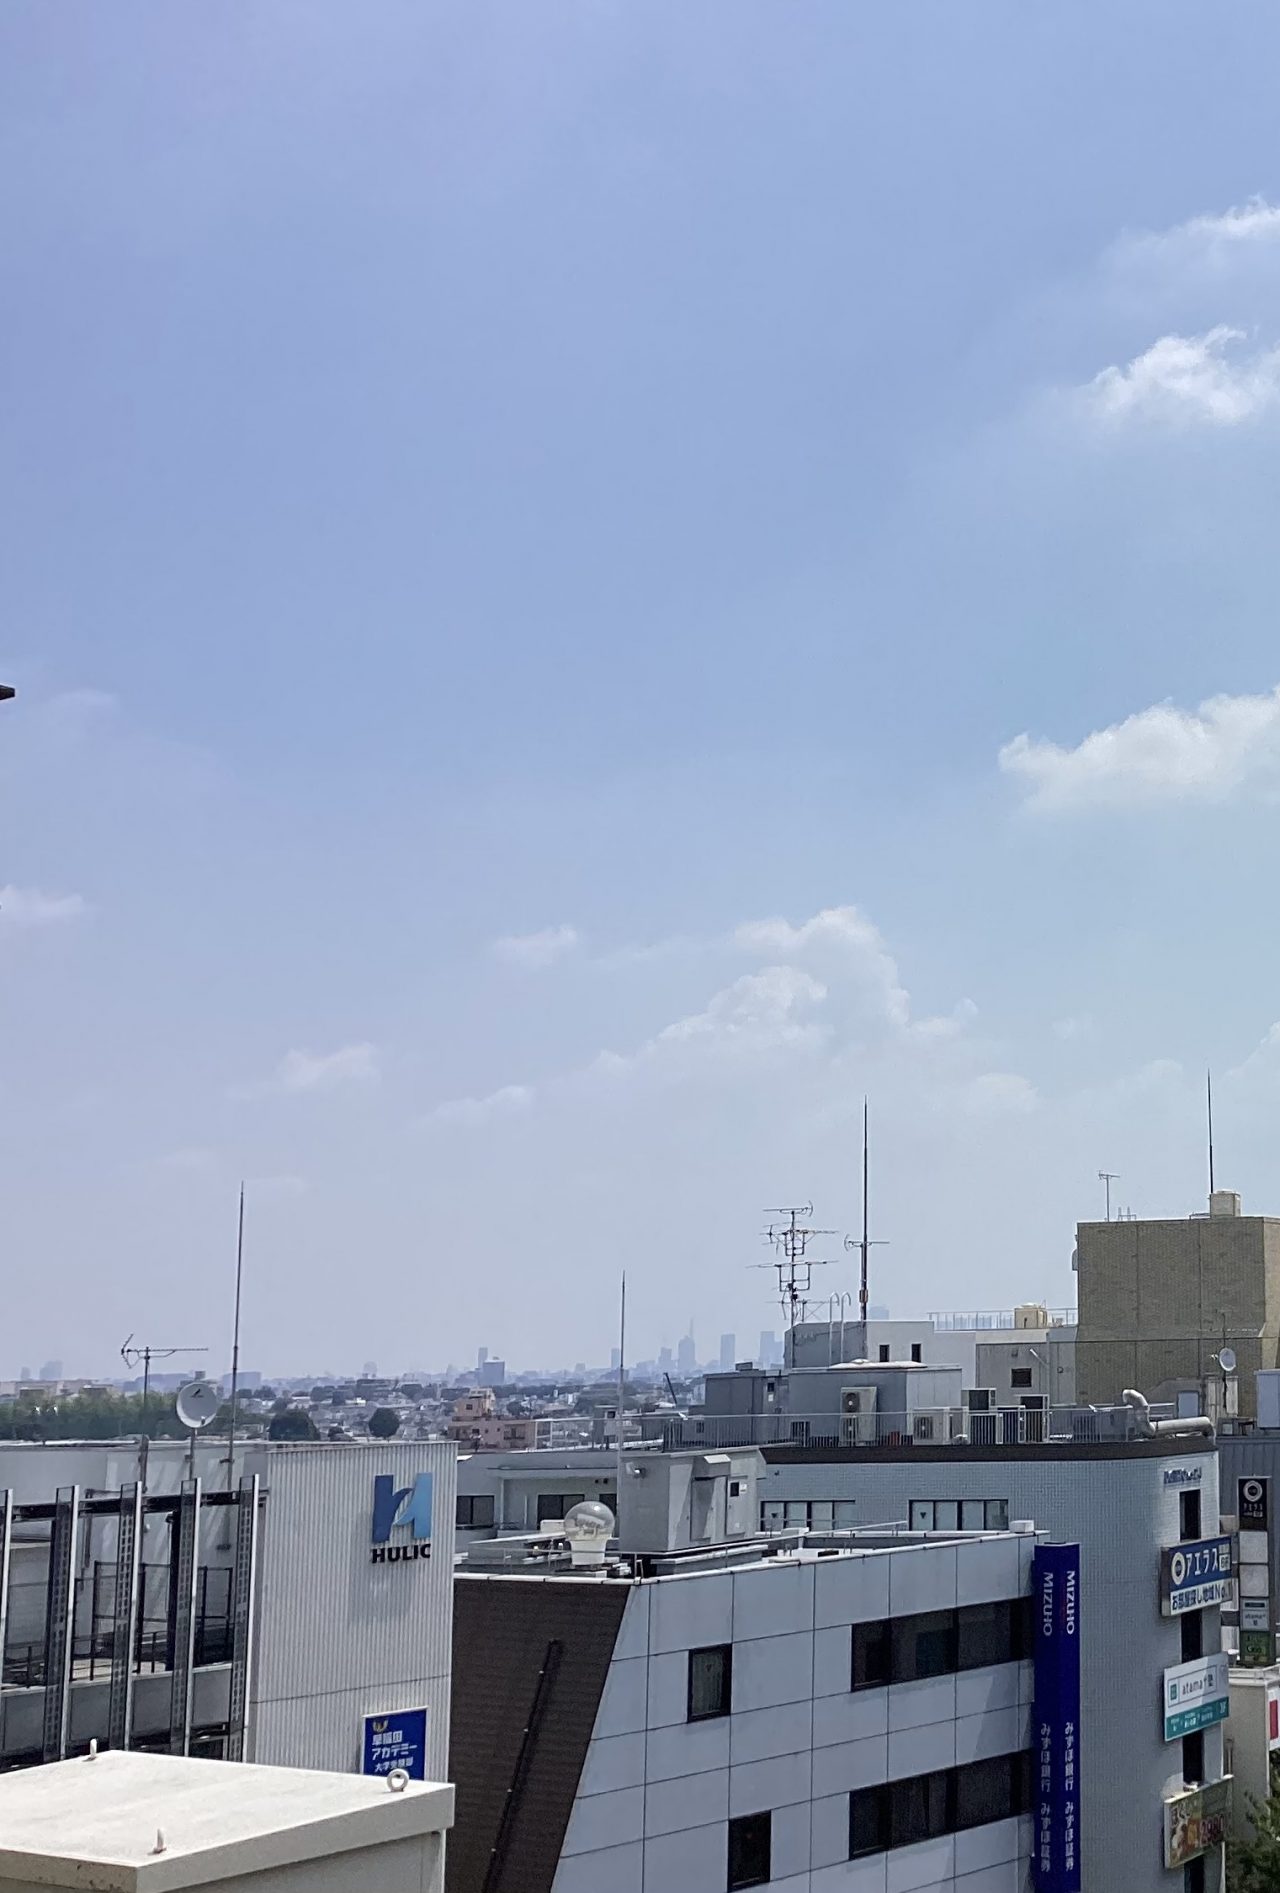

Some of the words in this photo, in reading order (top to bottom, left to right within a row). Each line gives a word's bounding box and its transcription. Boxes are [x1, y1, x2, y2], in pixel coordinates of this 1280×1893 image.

[372, 1543, 432, 1564] HULIC
[1185, 1548, 1218, 1578] アエラス
[1043, 1571, 1054, 1636] MIZUHO
[1066, 1570, 1076, 1635] MIZUHO
[372, 1743, 418, 1761] アカデミー
[1041, 1722, 1051, 1793] みずほ銀行
[1065, 1721, 1074, 1792] みずほ銀行
[1041, 1802, 1051, 1873] みずほ証券
[1065, 1801, 1074, 1872] みずほ証券
